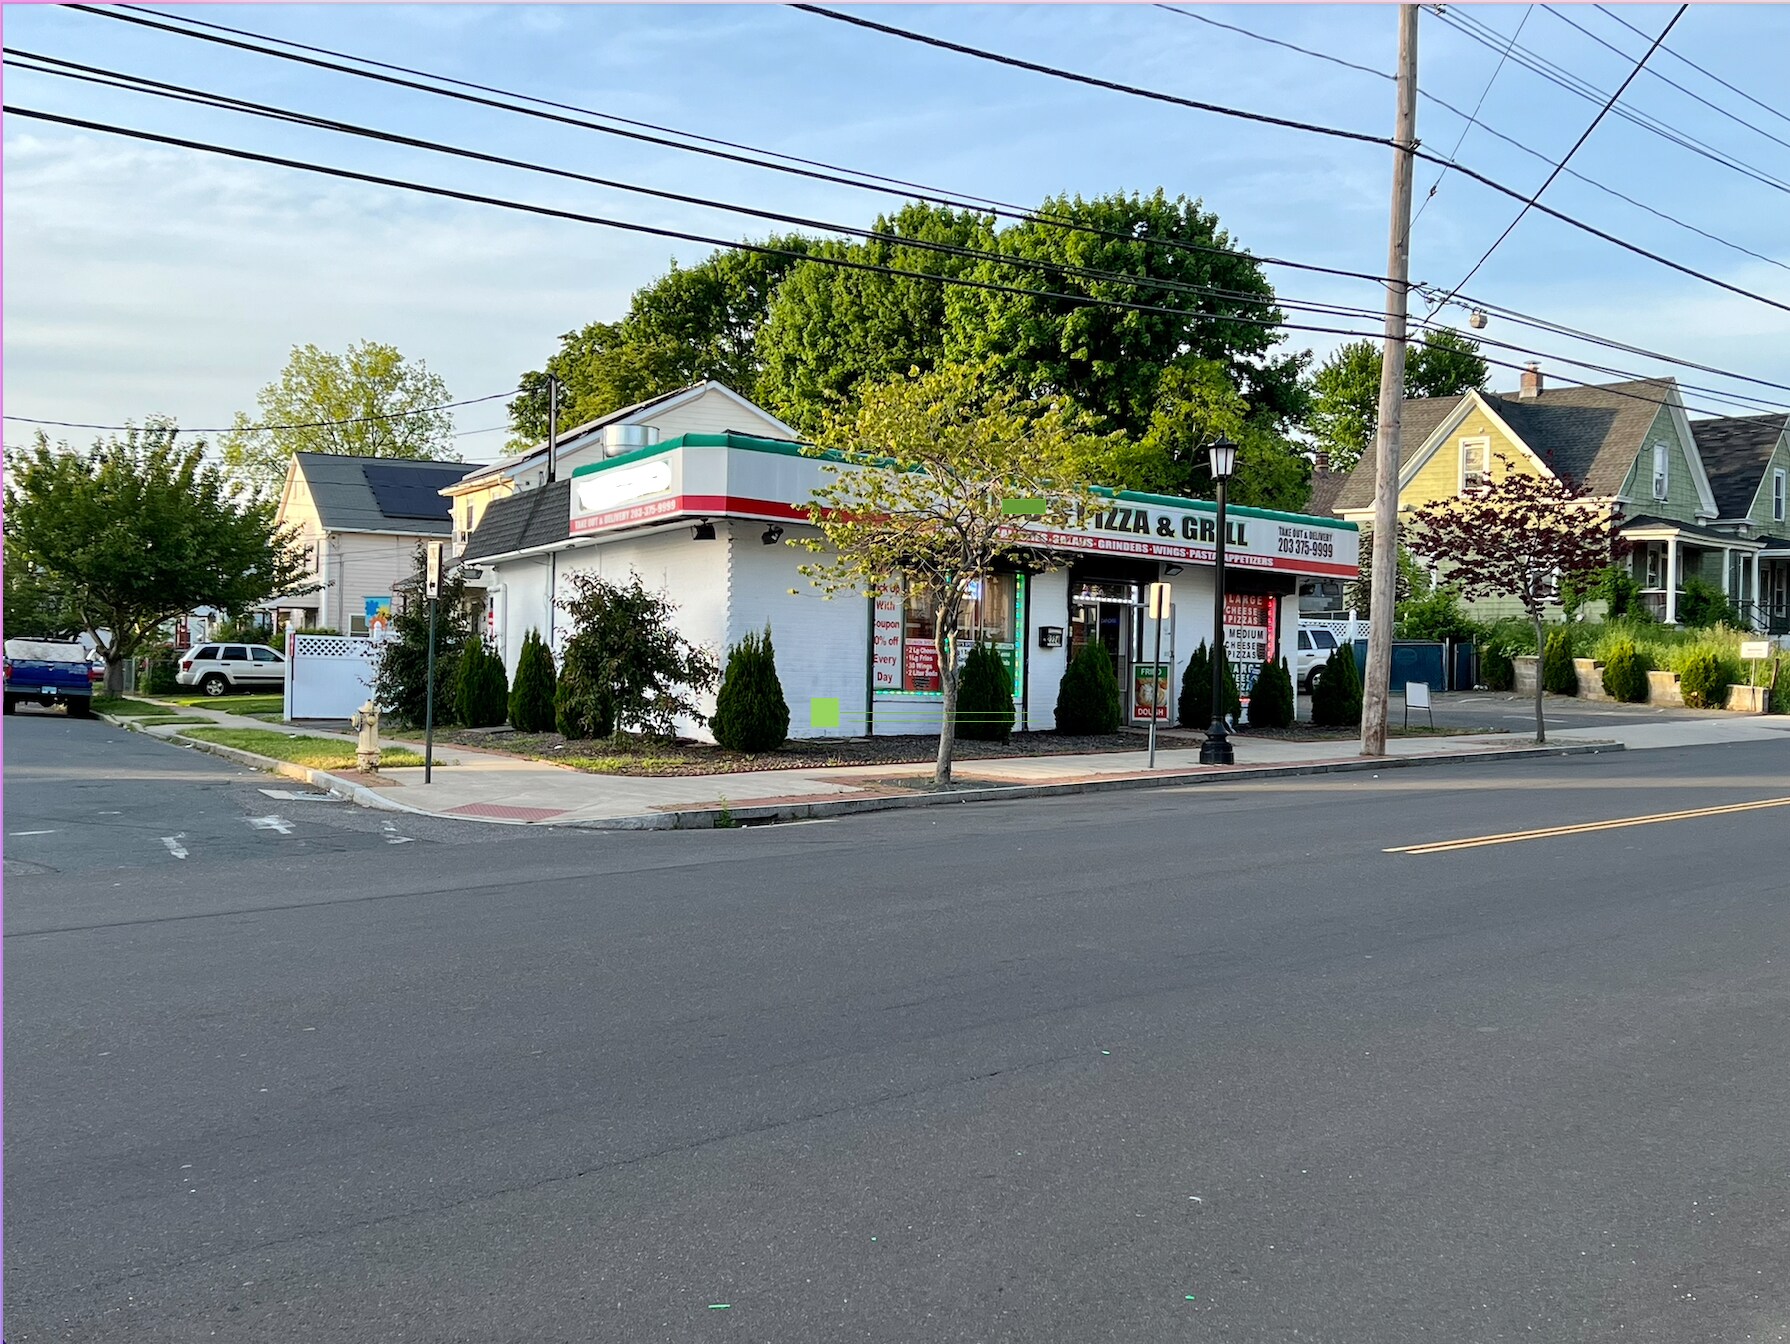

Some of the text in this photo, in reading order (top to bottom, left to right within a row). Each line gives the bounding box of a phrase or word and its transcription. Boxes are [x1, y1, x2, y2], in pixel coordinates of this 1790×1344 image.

[1156, 517, 1176, 538] &
[1181, 516, 1248, 546] GRLL
[1279, 526, 1332, 541] TAKE OUT & DELIVERY
[1097, 539, 1149, 553] GRINDERS
[1152, 546, 1186, 557] WINGS
[1278, 538, 1333, 557] 203 375-9999
[1229, 594, 1263, 605] LARGE
[877, 601, 895, 610] With
[1225, 606, 1258, 616] CHEESE
[875, 620, 899, 630] oupon
[1227, 614, 1258, 625] PIZZAS
[1229, 629, 1264, 639] MEDIUM
[888, 635, 899, 645] off
[1224, 641, 1256, 651] CHEESE
[873, 653, 897, 666] Every
[1227, 650, 1257, 660] PIZZAS
[877, 671, 893, 684] Day
